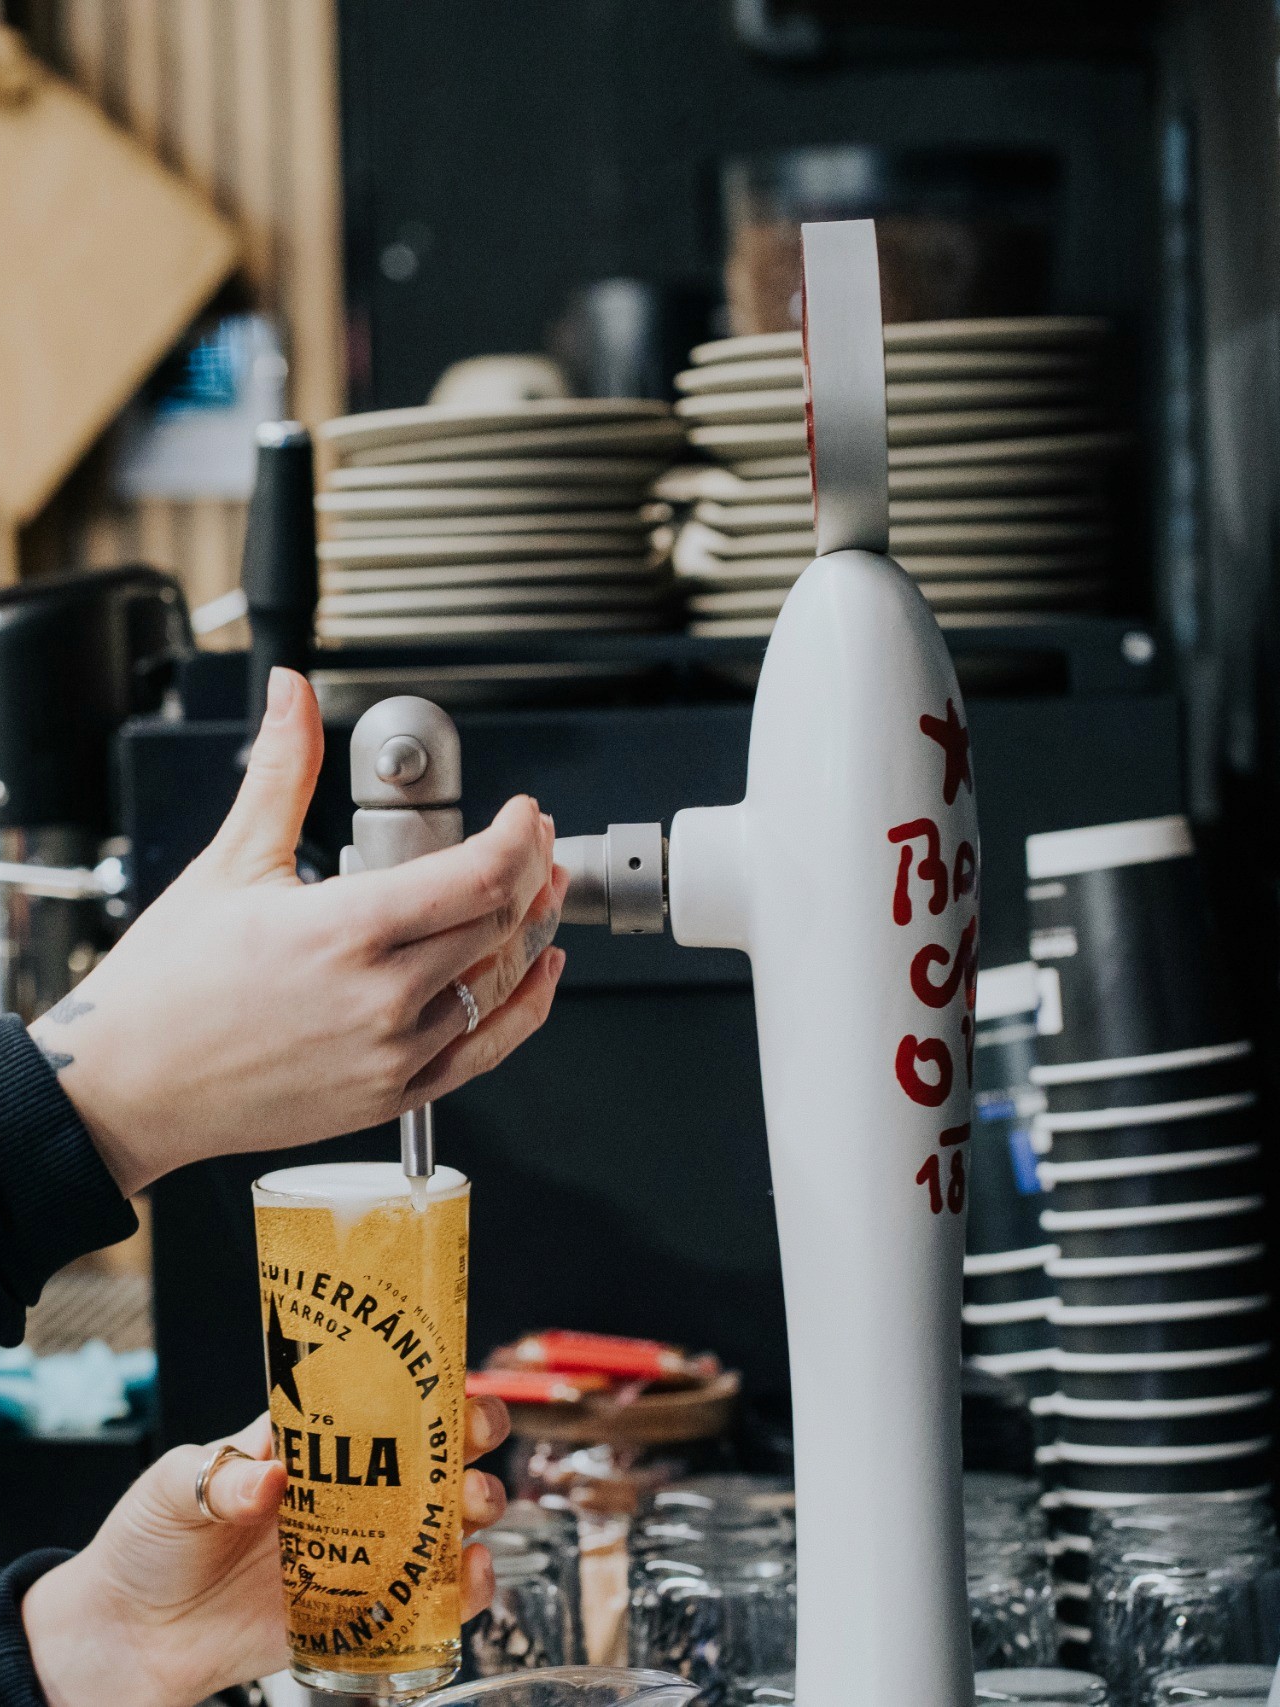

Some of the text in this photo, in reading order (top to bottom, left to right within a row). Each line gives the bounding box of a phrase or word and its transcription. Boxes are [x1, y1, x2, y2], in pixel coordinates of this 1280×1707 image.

[377, 1279, 408, 1303] 1904
[290, 1300, 352, 1342] ARROZ
[310, 1413, 335, 1426] 76
[428, 1416, 448, 1484] 1876
[307, 1522, 386, 1539] NATURALES
[388, 1503, 445, 1606] DAMM
